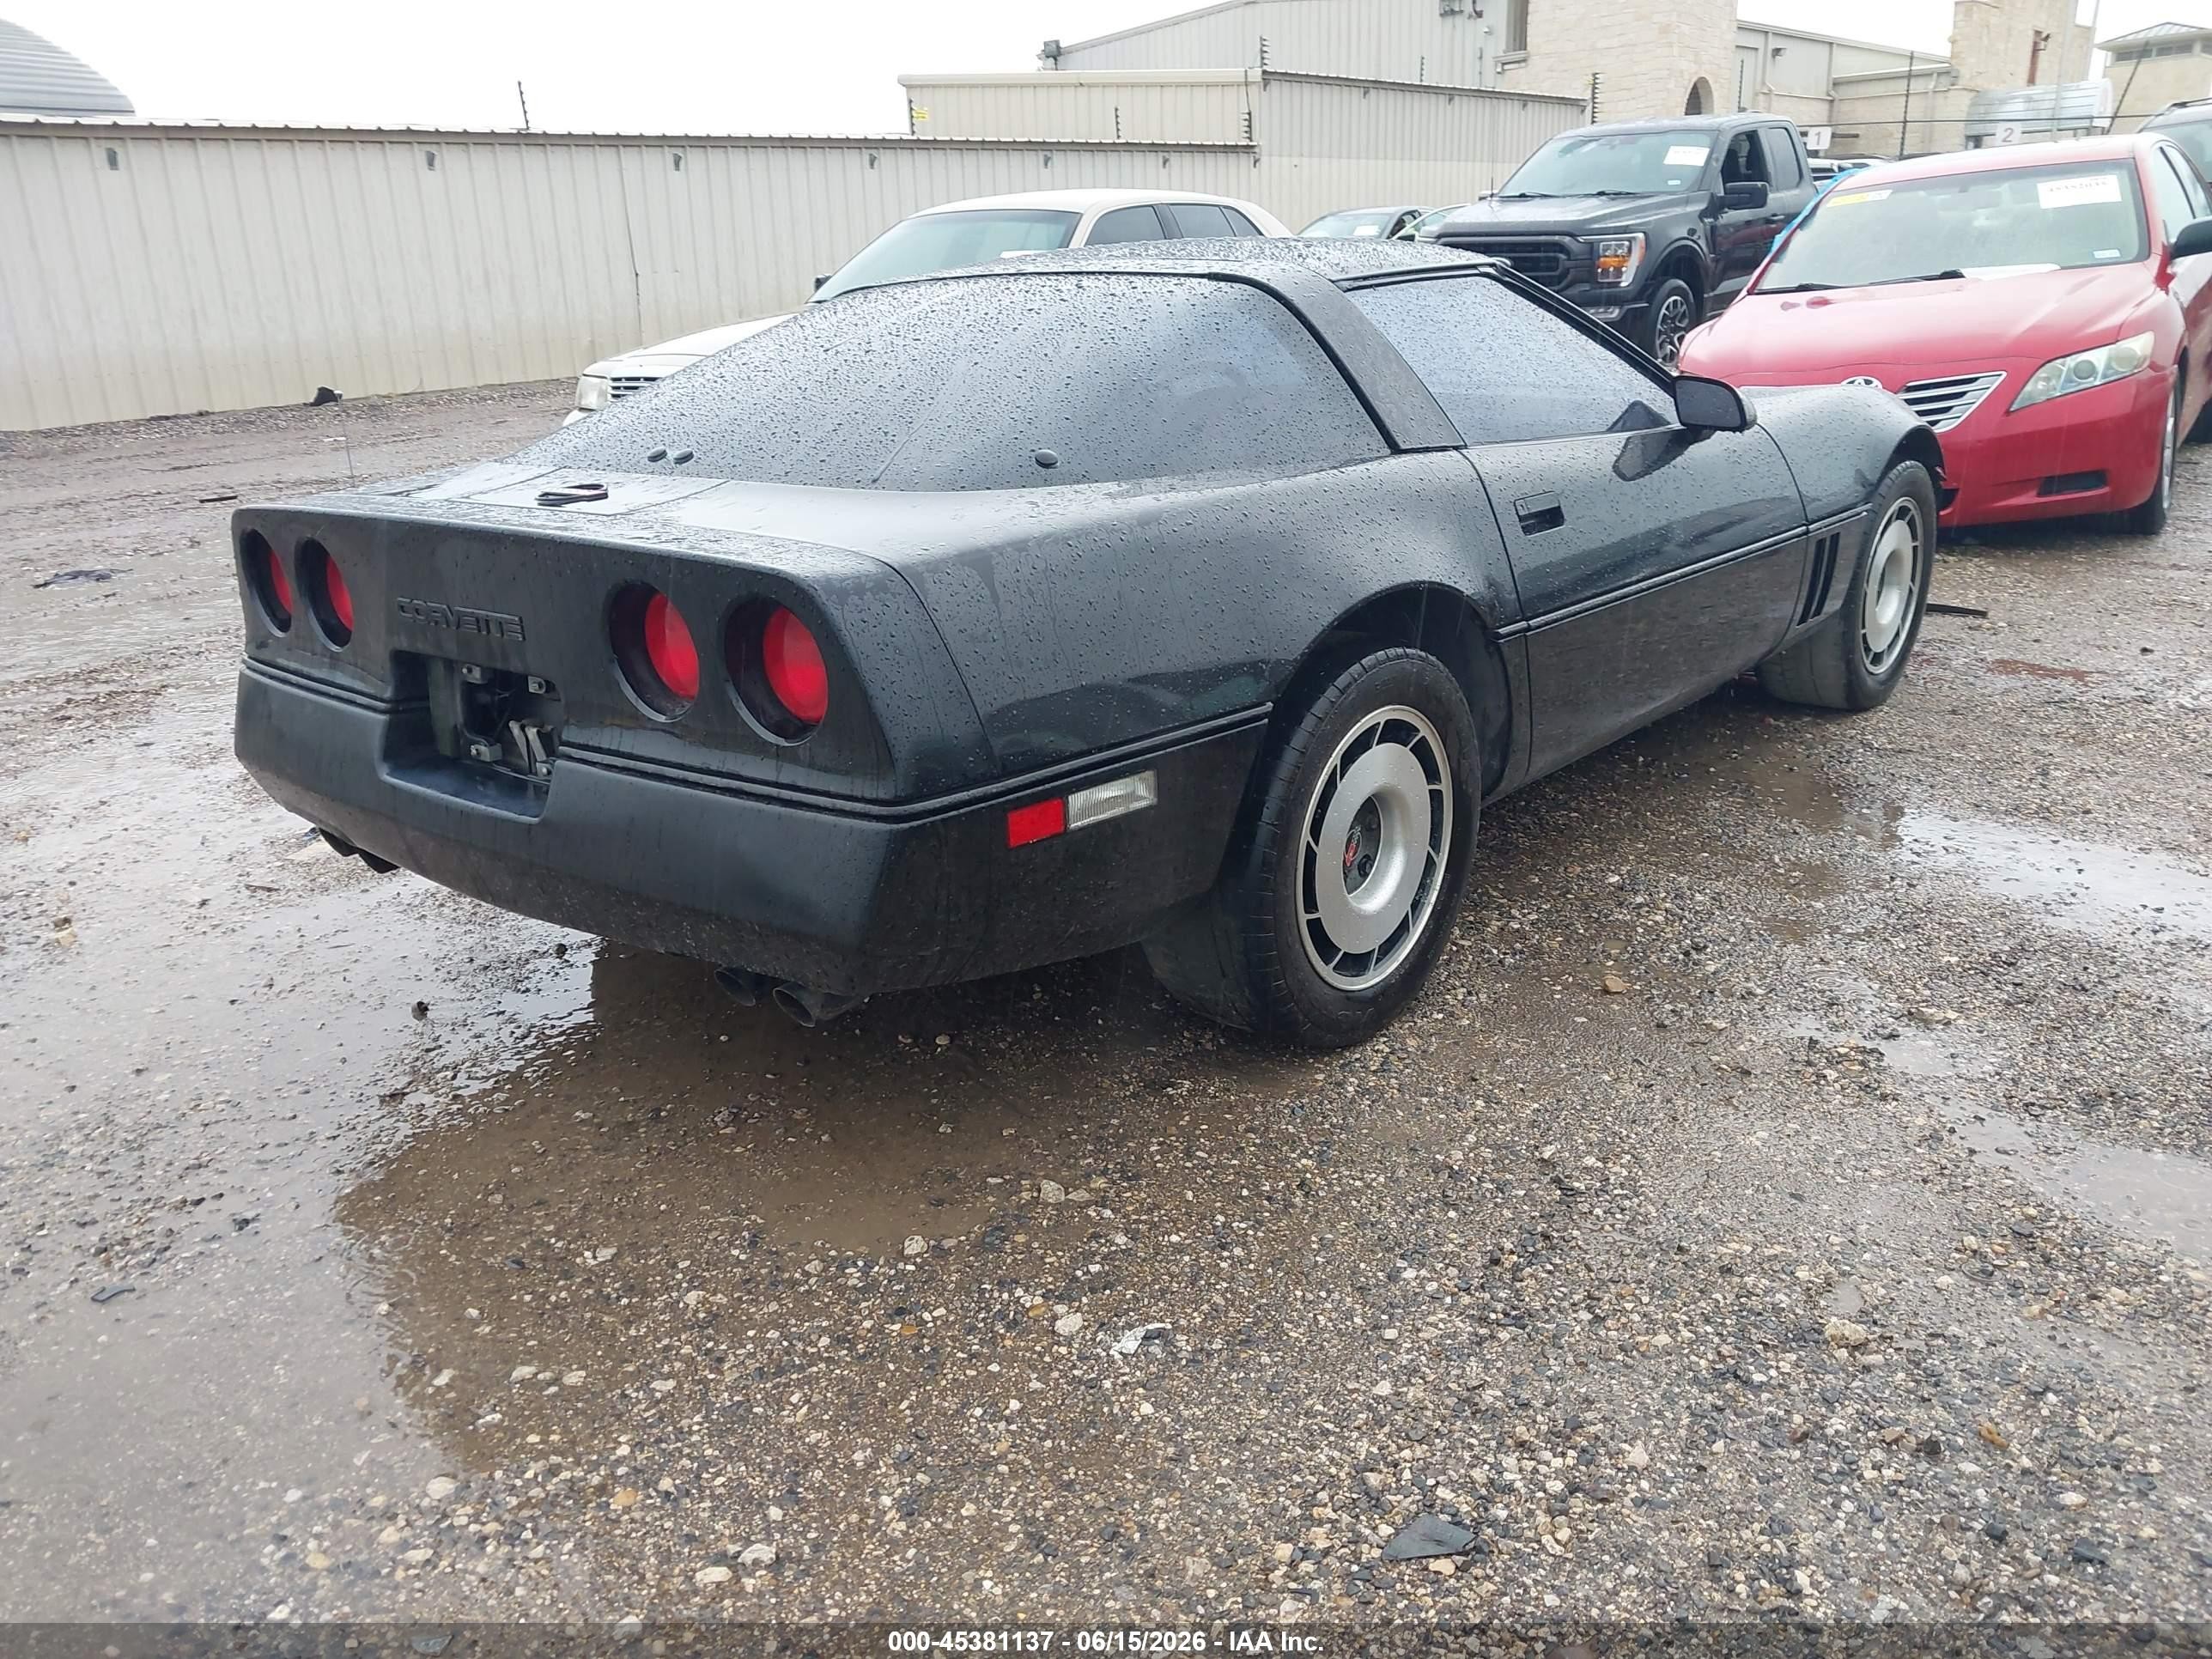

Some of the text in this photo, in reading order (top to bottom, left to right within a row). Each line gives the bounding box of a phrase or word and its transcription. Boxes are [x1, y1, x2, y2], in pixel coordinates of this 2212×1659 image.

[1814, 131, 1821, 145] 1
[2001, 127, 2014, 143] 2
[397, 597, 526, 641] CORVETTE
